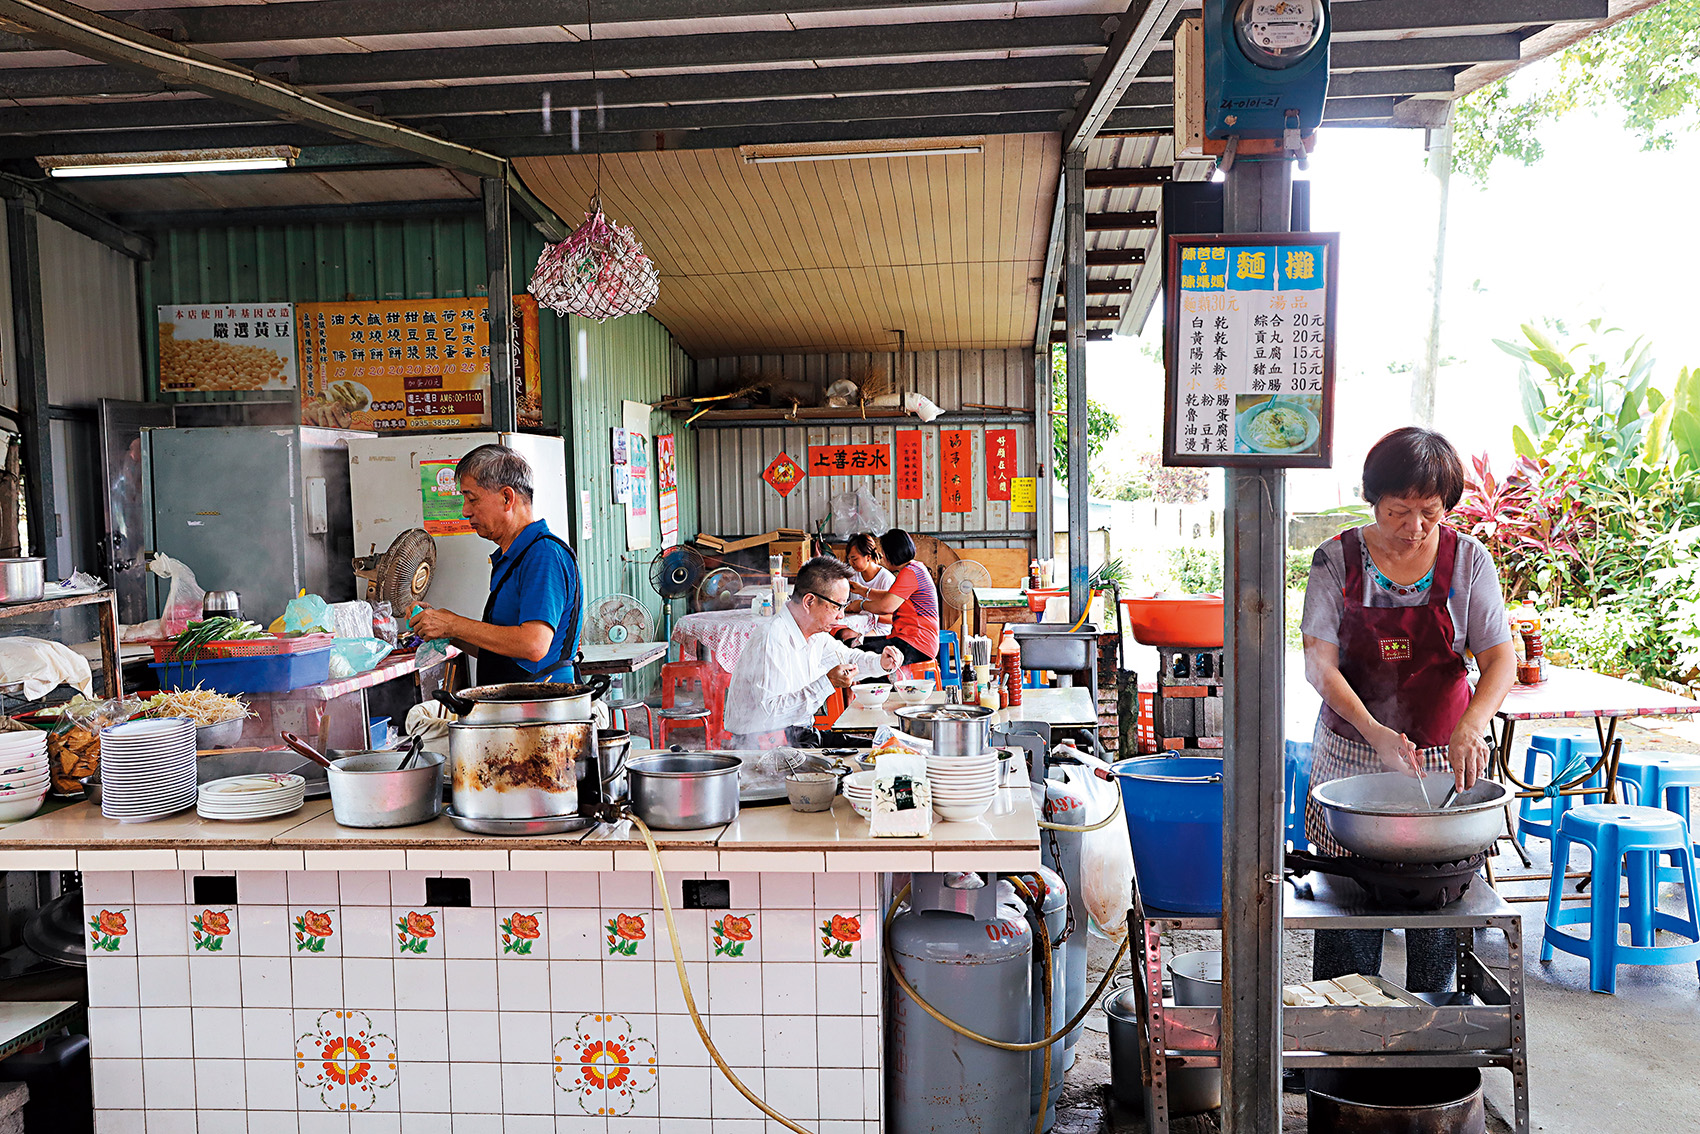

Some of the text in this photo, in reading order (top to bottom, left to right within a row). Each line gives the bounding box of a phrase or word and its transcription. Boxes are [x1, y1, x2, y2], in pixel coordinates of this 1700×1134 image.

[1182, 247, 1225, 260] 陳爸爸
[1200, 262, 1207, 274] &
[1182, 274, 1225, 288] 陳媽媽
[1270, 295, 1308, 310] 湯品
[176, 308, 290, 320] 本店使用非基因改造
[1254, 314, 1324, 328] 綜合 20元
[213, 322, 290, 338] 嚴選黃豆
[1254, 330, 1324, 344] 貢丸 20元
[1254, 346, 1324, 360] 豆腐 15元
[334, 367, 347, 377] 15
[352, 366, 365, 377] 15
[368, 366, 385, 376] 20
[388, 366, 404, 376] 20
[405, 365, 422, 375] 20
[424, 364, 440, 375] 30
[443, 364, 456, 374] 10
[460, 363, 476, 373] 25
[1252, 362, 1322, 375] 豬血 15元
[1252, 378, 1322, 392] 粉腸 30元
[440, 406, 454, 414] 公休
[1184, 423, 1230, 437] 油豆腐
[1184, 438, 1229, 452] 燙青菜
[814, 449, 888, 470] 上善若水
